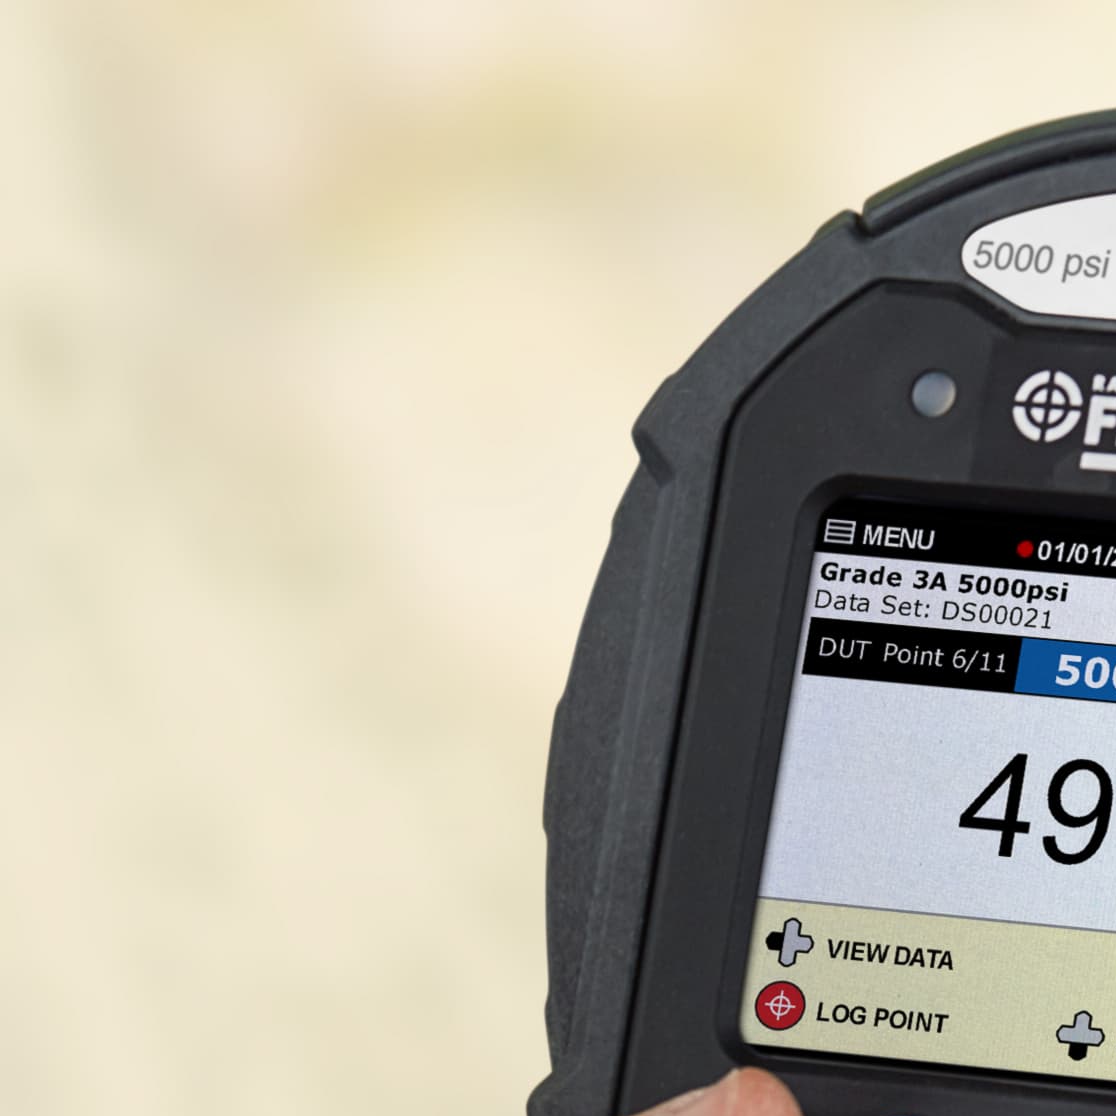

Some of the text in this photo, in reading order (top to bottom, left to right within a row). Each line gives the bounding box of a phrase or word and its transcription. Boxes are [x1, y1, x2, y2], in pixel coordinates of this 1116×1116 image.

[973, 240, 1055, 274] 5000
[1061, 249, 1112, 284] psi
[862, 524, 935, 550] MENU
[819, 562, 1069, 603] Grade 3A 5000psi
[814, 589, 1053, 630] Data Set: DS00021
[818, 637, 1007, 673] DUT Point 6/11
[826, 938, 954, 971] VIEW DATA
[816, 1001, 949, 1034] LOG POINT
